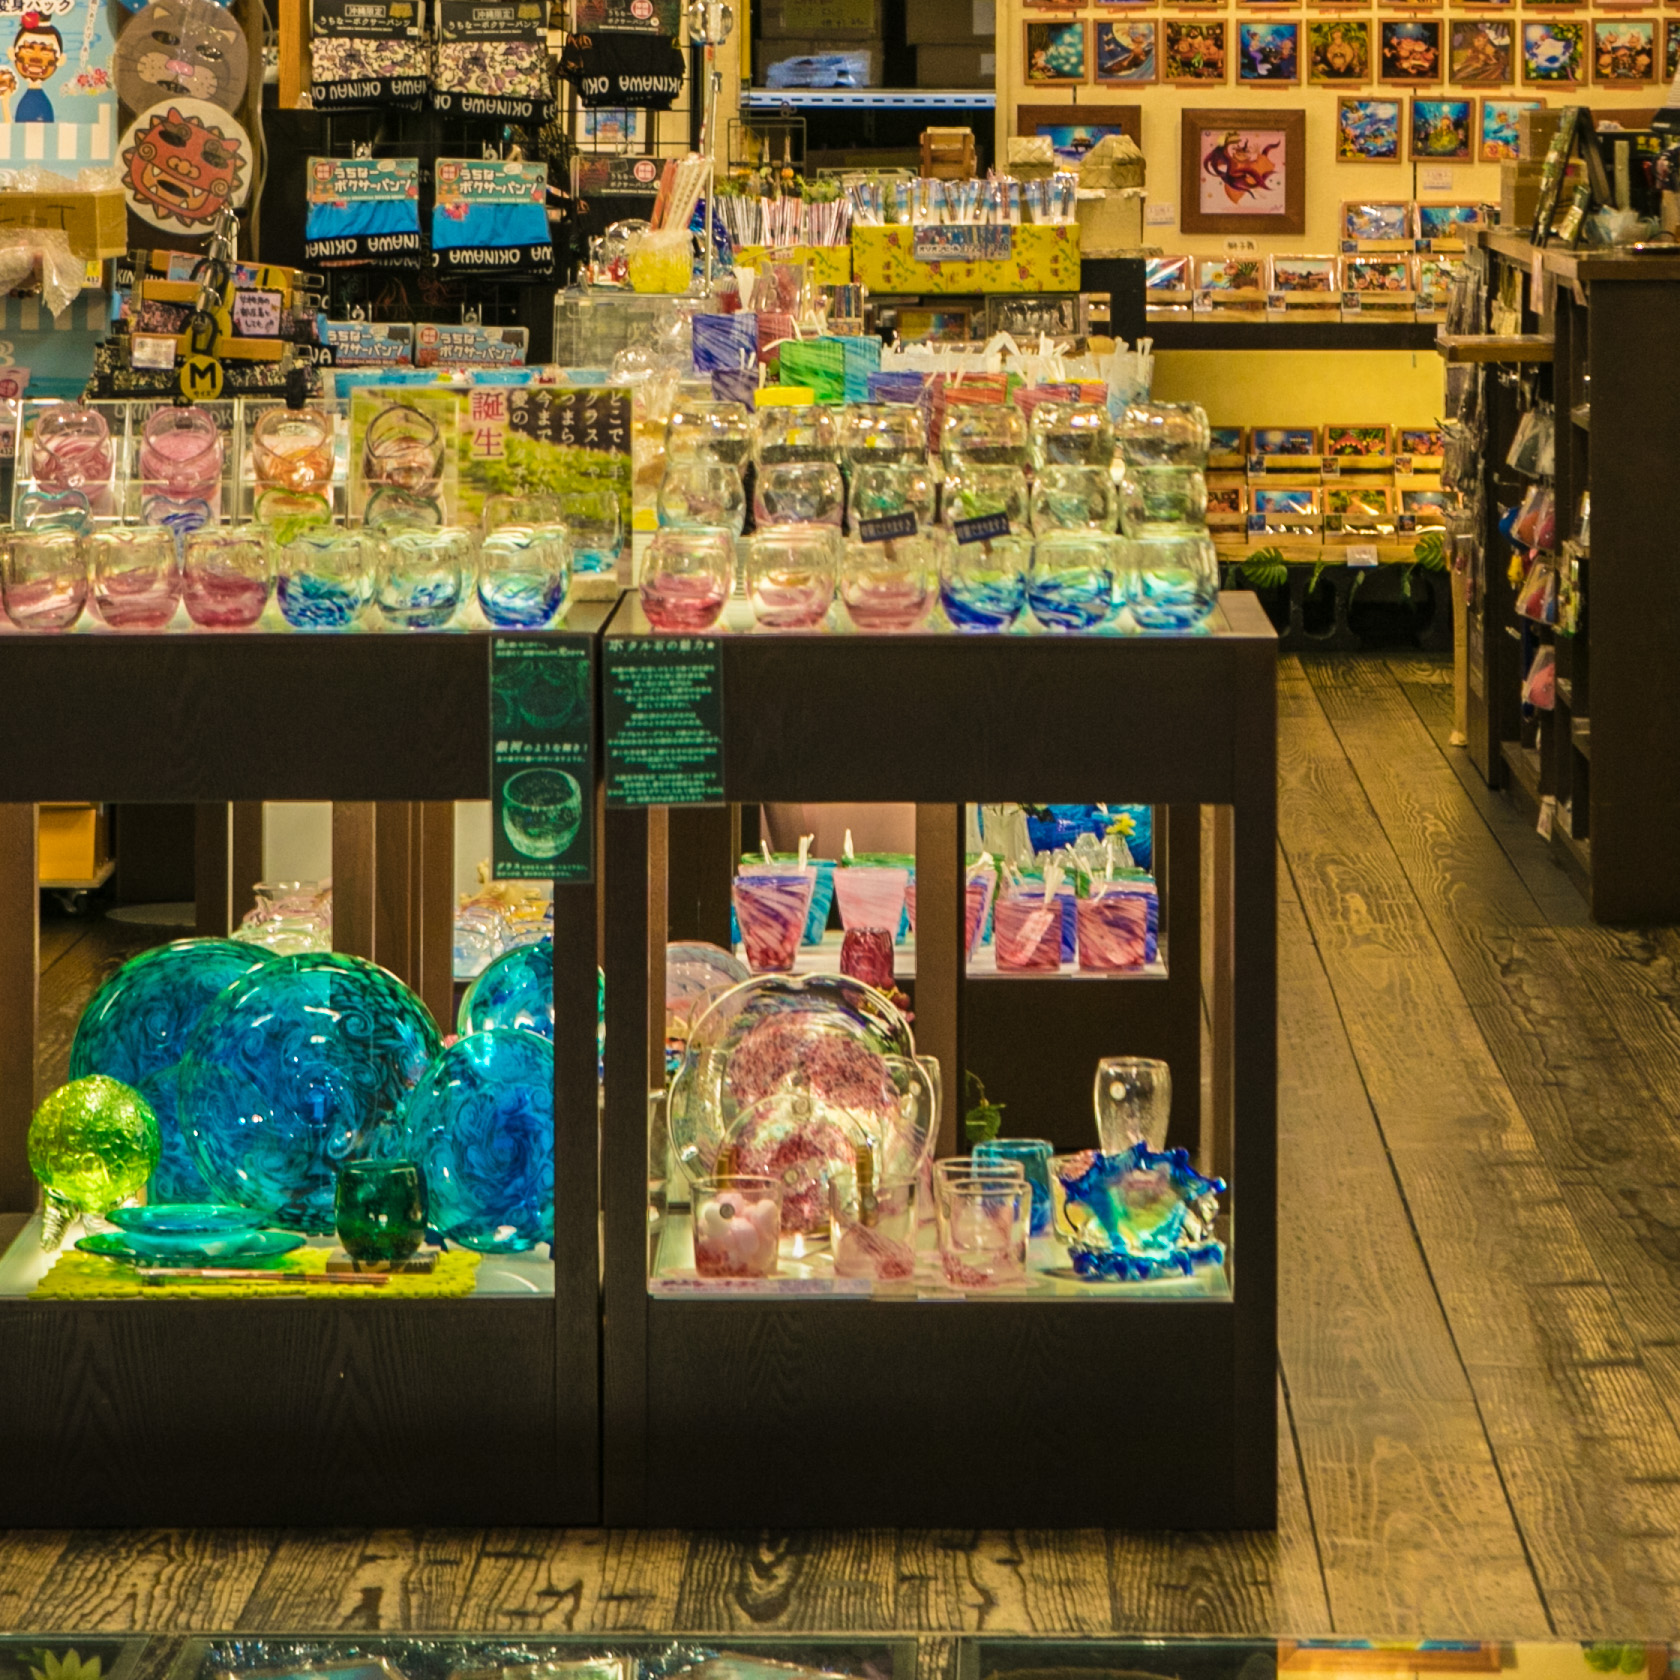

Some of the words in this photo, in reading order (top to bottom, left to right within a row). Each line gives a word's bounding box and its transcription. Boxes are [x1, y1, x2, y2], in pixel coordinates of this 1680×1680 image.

[320, 17, 411, 28] うちなーボクサーパンツ
[448, 20, 540, 31] うちなーボクサーパンツ
[461, 96, 533, 118] OKINAWA
[334, 167, 380, 180] うちなー
[459, 168, 506, 180] うちなー
[334, 179, 412, 194] ボクサーパンツ
[459, 179, 538, 195] ボクサーパンツ
[449, 248, 521, 267] OKINAWA
[328, 330, 372, 342] うちなー
[440, 333, 487, 345] うちなー
[440, 345, 517, 361] ボクサーパンツ
[189, 362, 217, 389] M
[472, 391, 505, 458] 誕生
